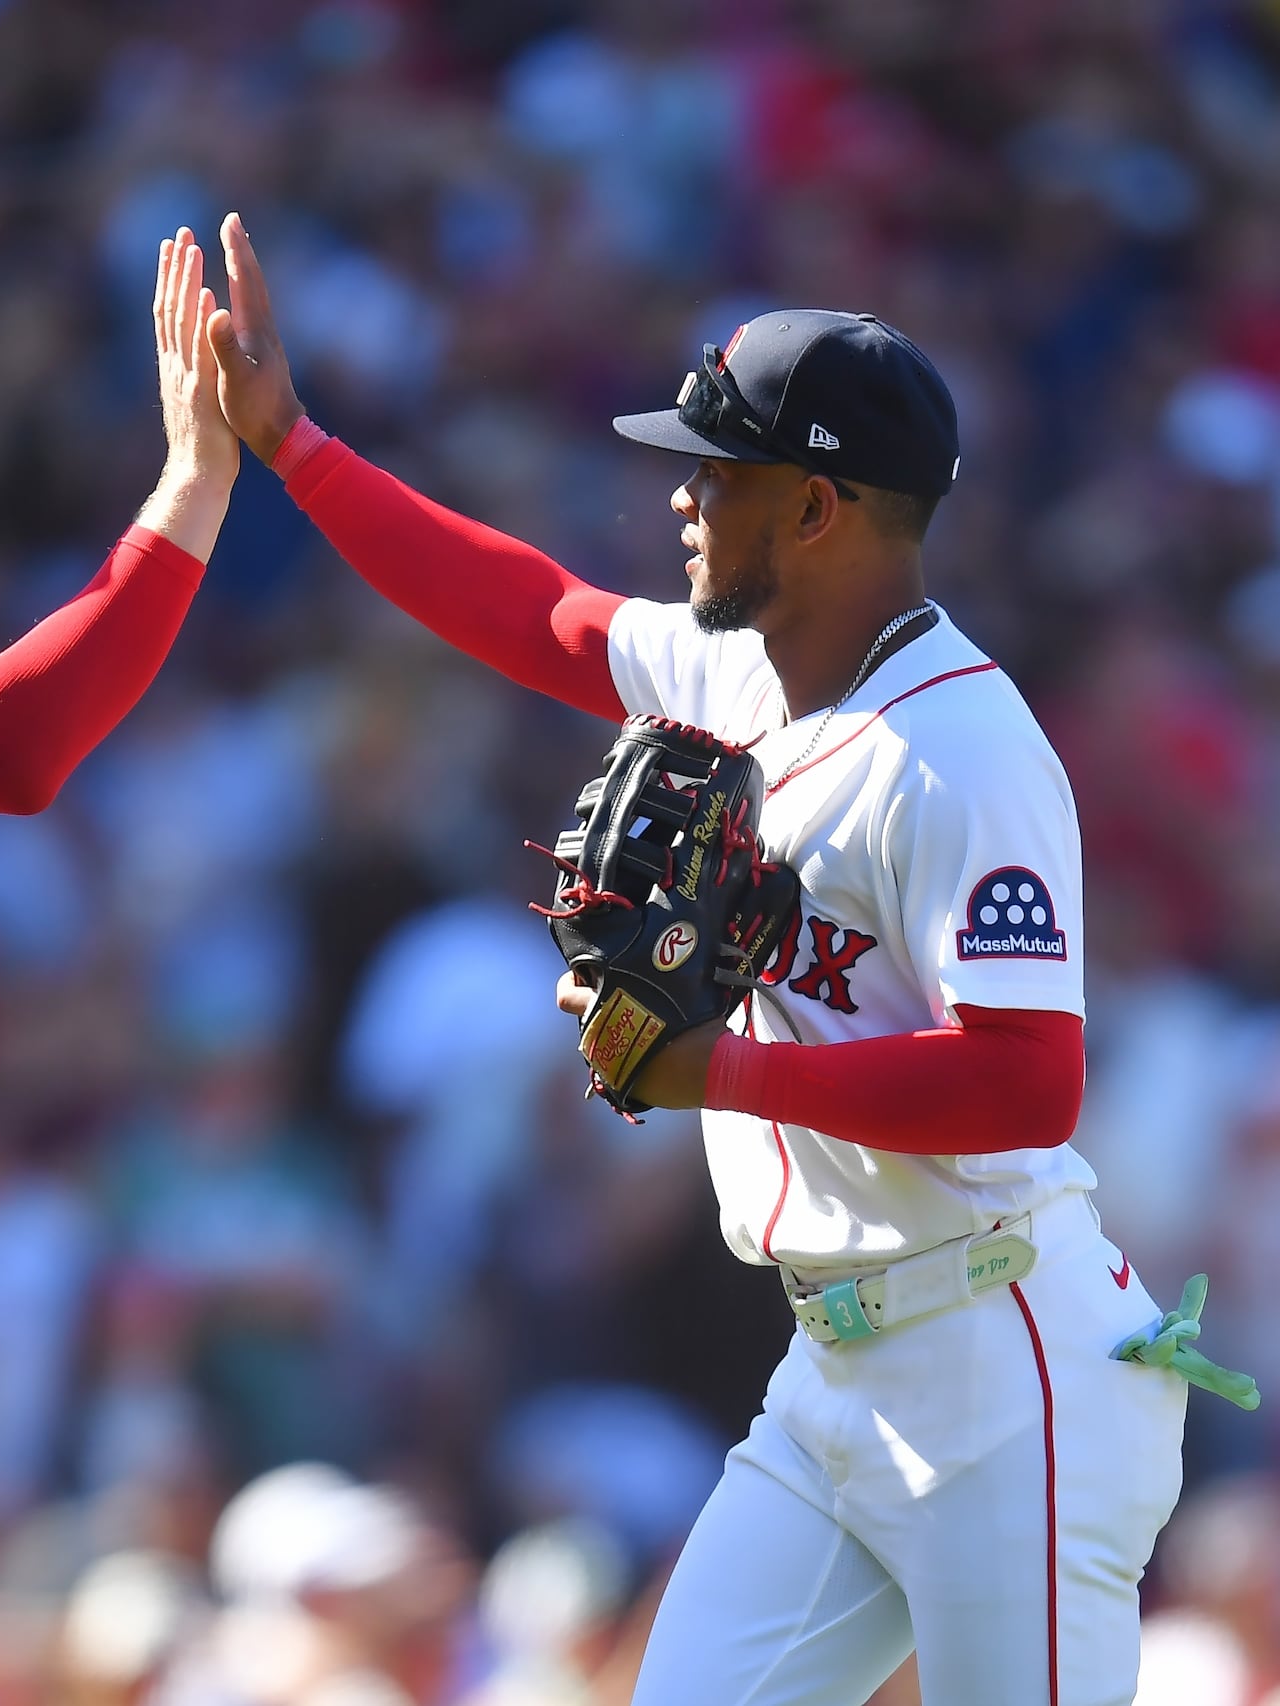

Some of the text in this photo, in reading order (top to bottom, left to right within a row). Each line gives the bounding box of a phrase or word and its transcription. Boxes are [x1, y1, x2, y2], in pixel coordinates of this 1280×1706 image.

[692, 790, 727, 845] Rafaela
[961, 933, 1063, 955] MassMutual
[592, 1006, 636, 1073] Rawlings
[836, 1300, 854, 1328] 3
